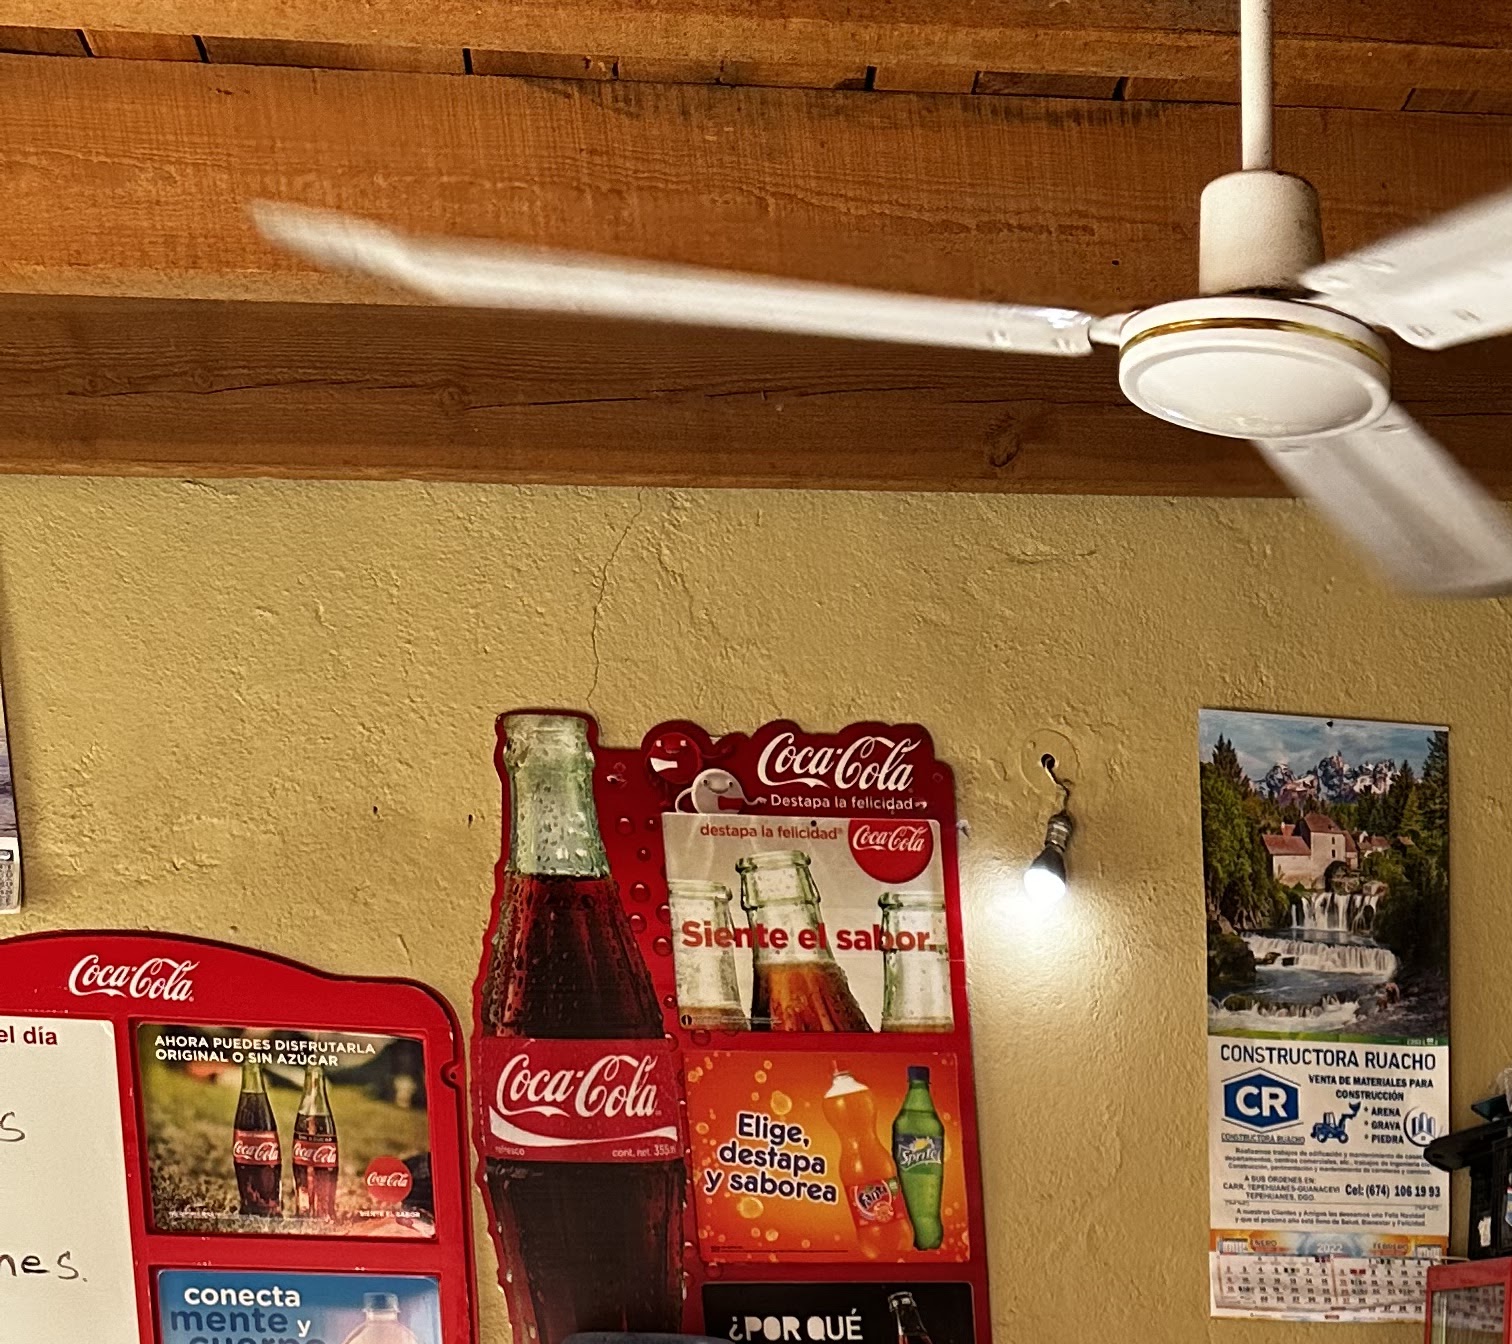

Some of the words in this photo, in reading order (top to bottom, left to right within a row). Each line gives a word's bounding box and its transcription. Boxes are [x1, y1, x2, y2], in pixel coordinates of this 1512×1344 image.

[757, 732, 921, 792] Coca-Cola
[770, 793, 831, 810] Destapa
[834, 795, 847, 808] la
[850, 797, 913, 811] felicidad
[700, 824, 757, 839] destapa
[761, 825, 774, 838] la
[852, 824, 929, 853] Coca-Cola
[681, 920, 788, 948] Siente
[798, 922, 826, 949] el
[836, 924, 937, 951] sabor.
[68, 954, 200, 1002] Coca-Cola
[23, 1026, 58, 1045] día
[154, 1035, 209, 1049] AHORA
[213, 1037, 271, 1050] PUEDES
[275, 1040, 376, 1055] DISFRUTARLA
[156, 1048, 228, 1063] ORIGINAL
[232, 1051, 244, 1063] O
[248, 1052, 273, 1064] SIN
[277, 1051, 338, 1067] AZÚCAR
[1221, 1044, 1359, 1068] CONSTRUCTORA
[1365, 1051, 1436, 1070] RUACHO
[497, 1054, 658, 1118] Coca-Cola
[1308, 1074, 1337, 1085] VENTA
[1339, 1076, 1351, 1085] DE
[1353, 1077, 1407, 1088] MATERIALES
[1409, 1079, 1434, 1088] PARA
[1236, 1085, 1288, 1118] CR
[1335, 1089, 1404, 1101] CONSTRUCCIÓN
[1371, 1107, 1401, 1117] ARENA
[737, 1112, 810, 1148] Elige,
[1371, 1120, 1401, 1131] GRAVA
[233, 1140, 279, 1161] Coca-Cola
[1371, 1134, 1404, 1144] PIEDRA
[292, 1141, 337, 1164] Coca-Cola
[718, 1141, 826, 1177] destapa
[367, 1171, 409, 1188] Coca-Cola
[705, 1169, 723, 1193] y
[729, 1171, 838, 1204] saborea
[1345, 1184, 1364, 1196] Cel:
[1365, 1184, 1390, 1199] (674)
[1414, 1185, 1426, 1197] 19
[1428, 1186, 1441, 1198] 93
[184, 1285, 301, 1308] conecta
[171, 1307, 288, 1333] mente
[297, 1319, 312, 1338] y
[729, 1315, 802, 1341] ¿POR
[807, 1308, 863, 1341] QUÉ
